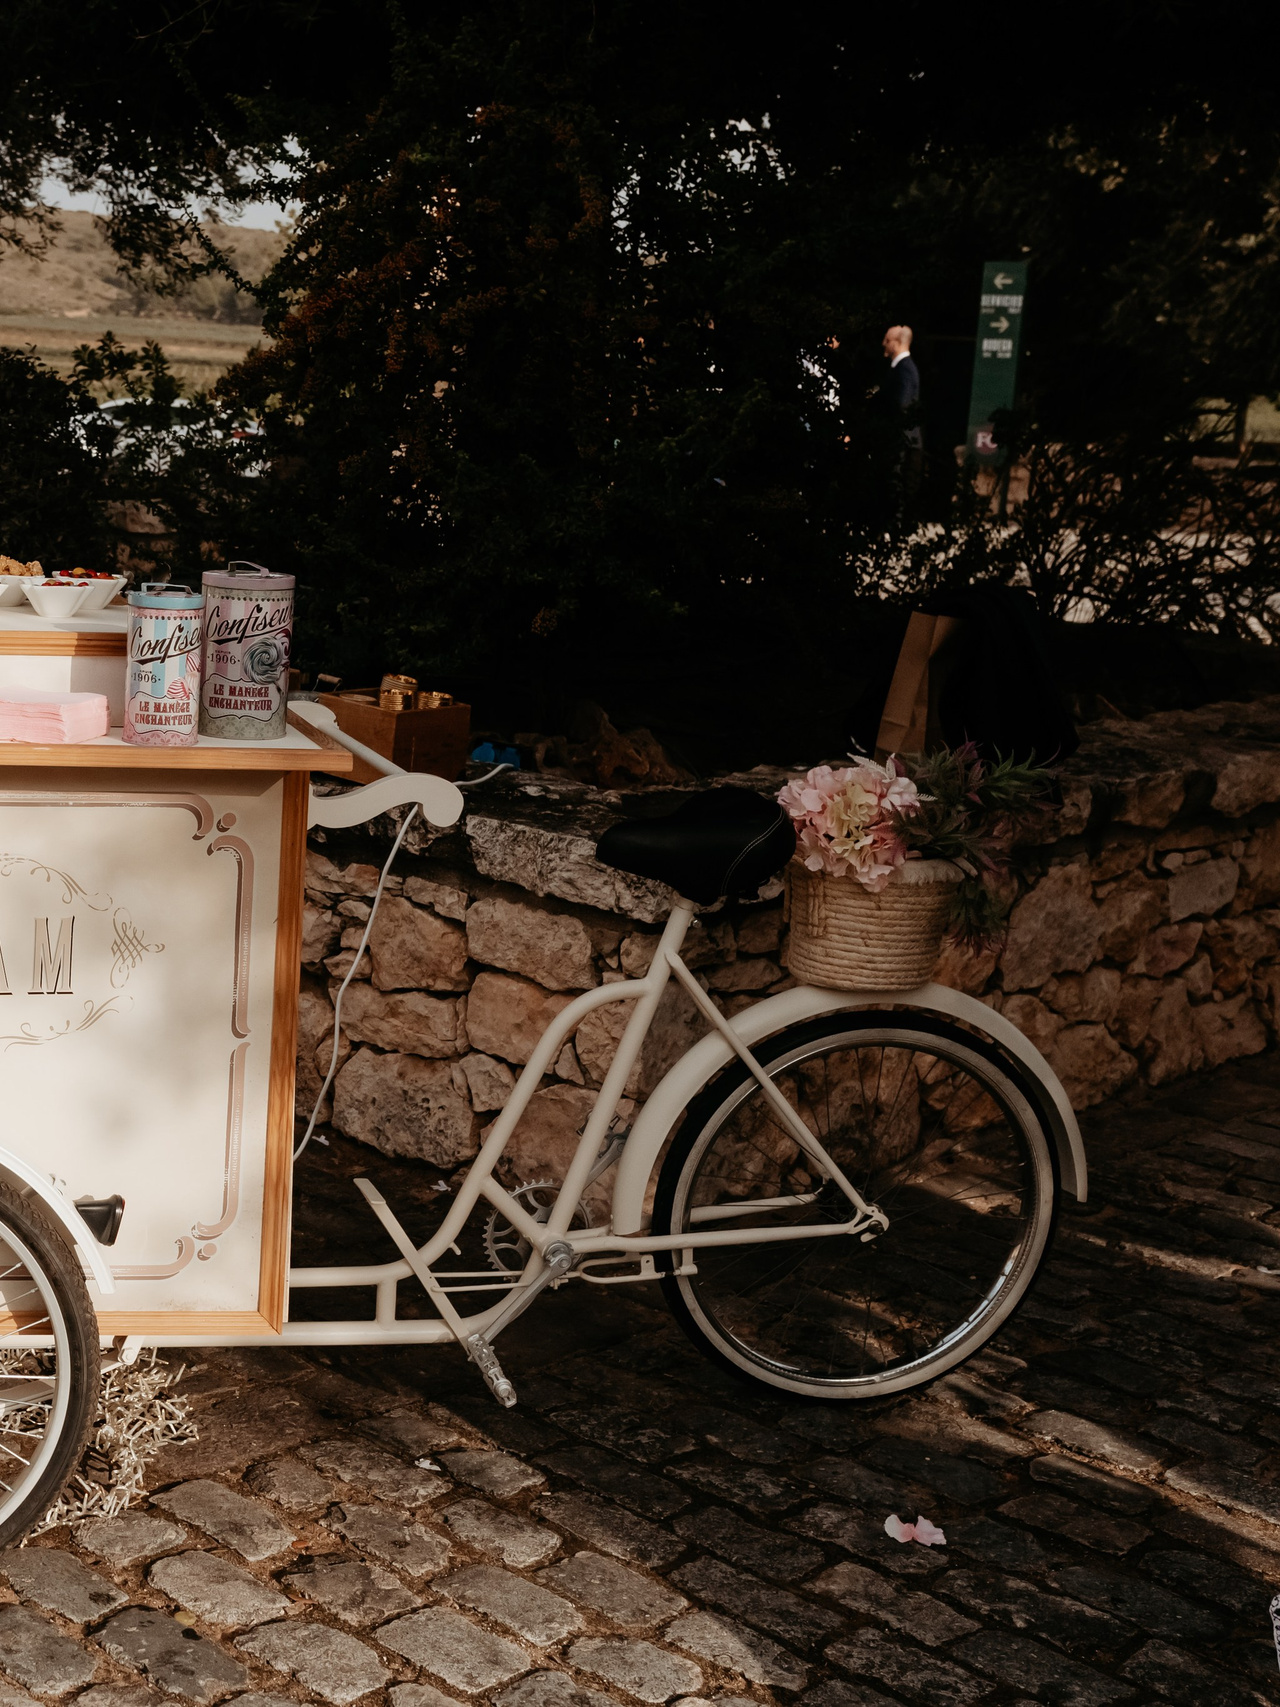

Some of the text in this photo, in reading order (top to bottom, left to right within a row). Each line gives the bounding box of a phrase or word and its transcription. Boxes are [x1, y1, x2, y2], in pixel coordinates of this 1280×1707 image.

[213, 684, 225, 695] LE
[139, 701, 150, 712] LE
[209, 696, 273, 711] ENCHANTEUR
[134, 713, 193, 726] ENCHANTEUR
